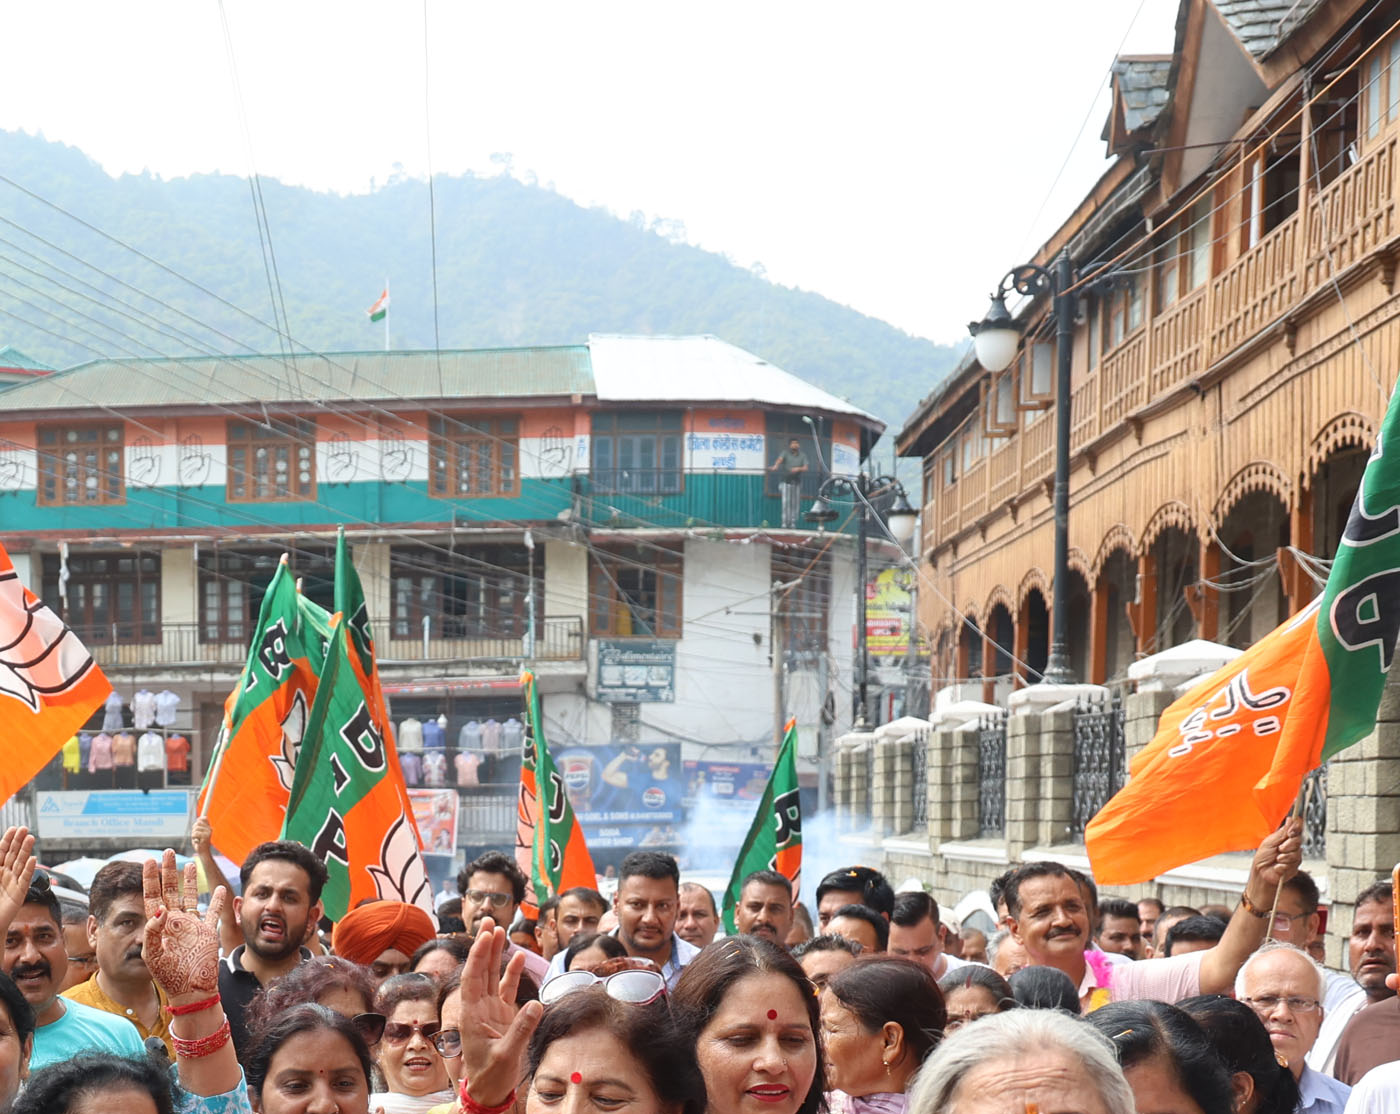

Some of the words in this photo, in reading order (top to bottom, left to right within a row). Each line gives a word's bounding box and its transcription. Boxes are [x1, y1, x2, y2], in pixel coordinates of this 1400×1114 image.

[63, 817, 98, 827] Branch
[100, 816, 131, 827] Office
[133, 816, 164, 826] Mandi
